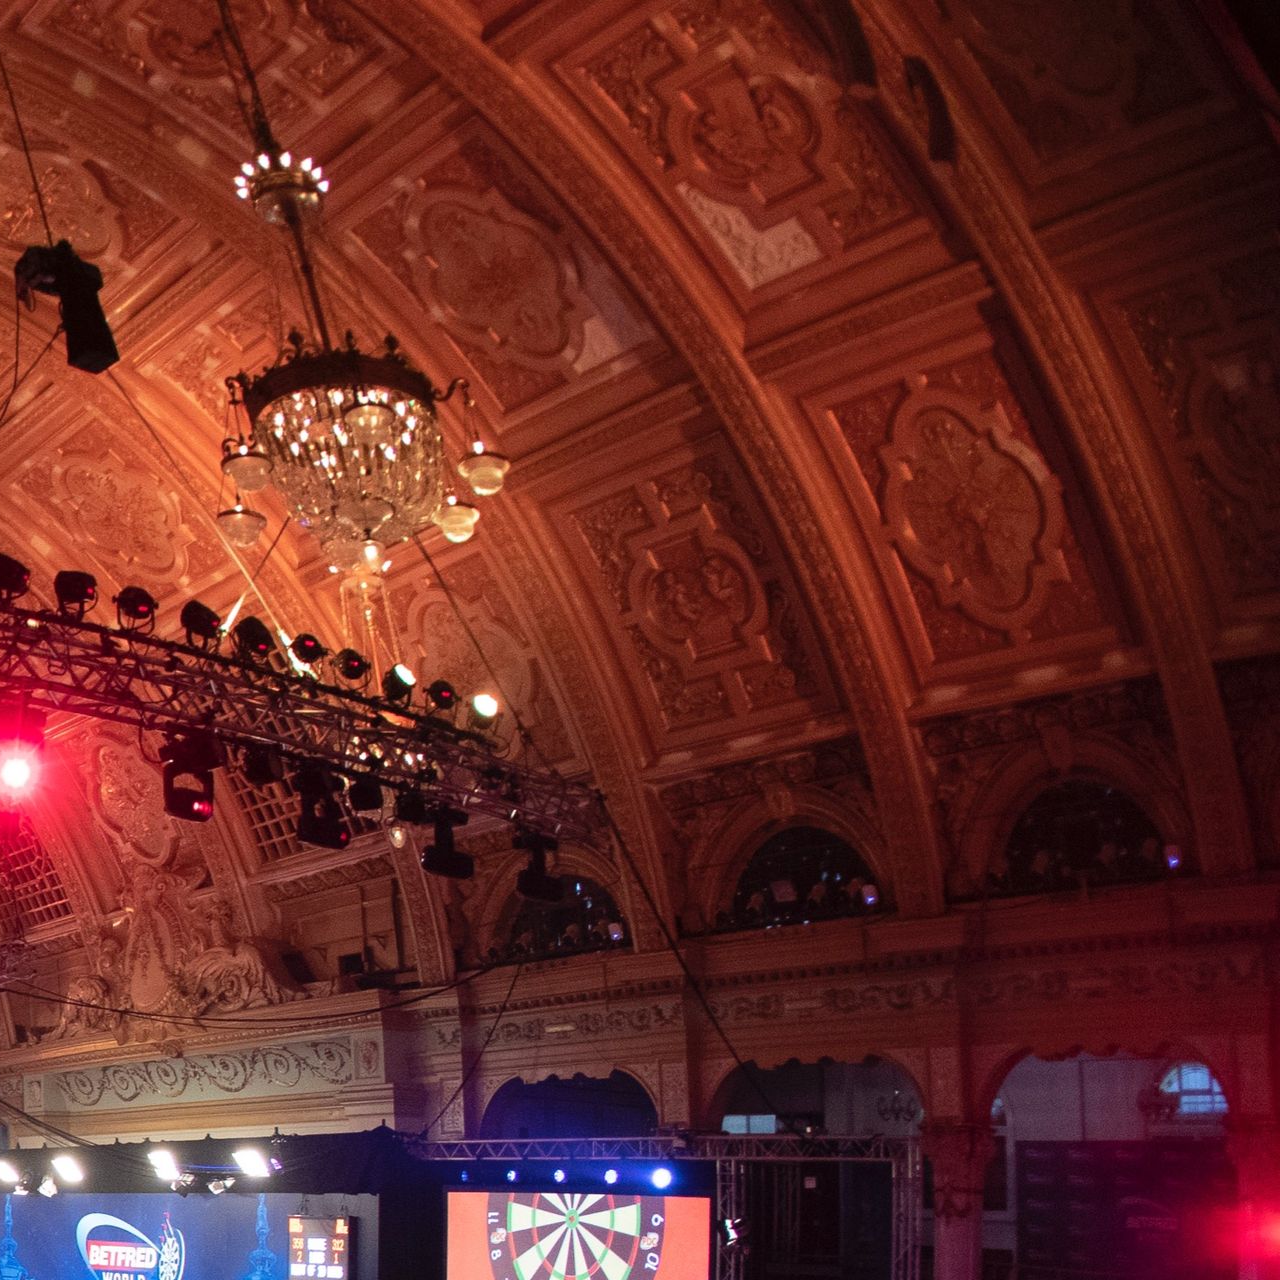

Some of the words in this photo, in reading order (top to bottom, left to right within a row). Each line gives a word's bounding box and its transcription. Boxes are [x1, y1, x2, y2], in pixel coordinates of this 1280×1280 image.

[651, 1213, 664, 1227] 9
[88, 1244, 158, 1269] BETFRED
[491, 1249, 502, 1260] 8
[644, 1253, 660, 1271] 10
